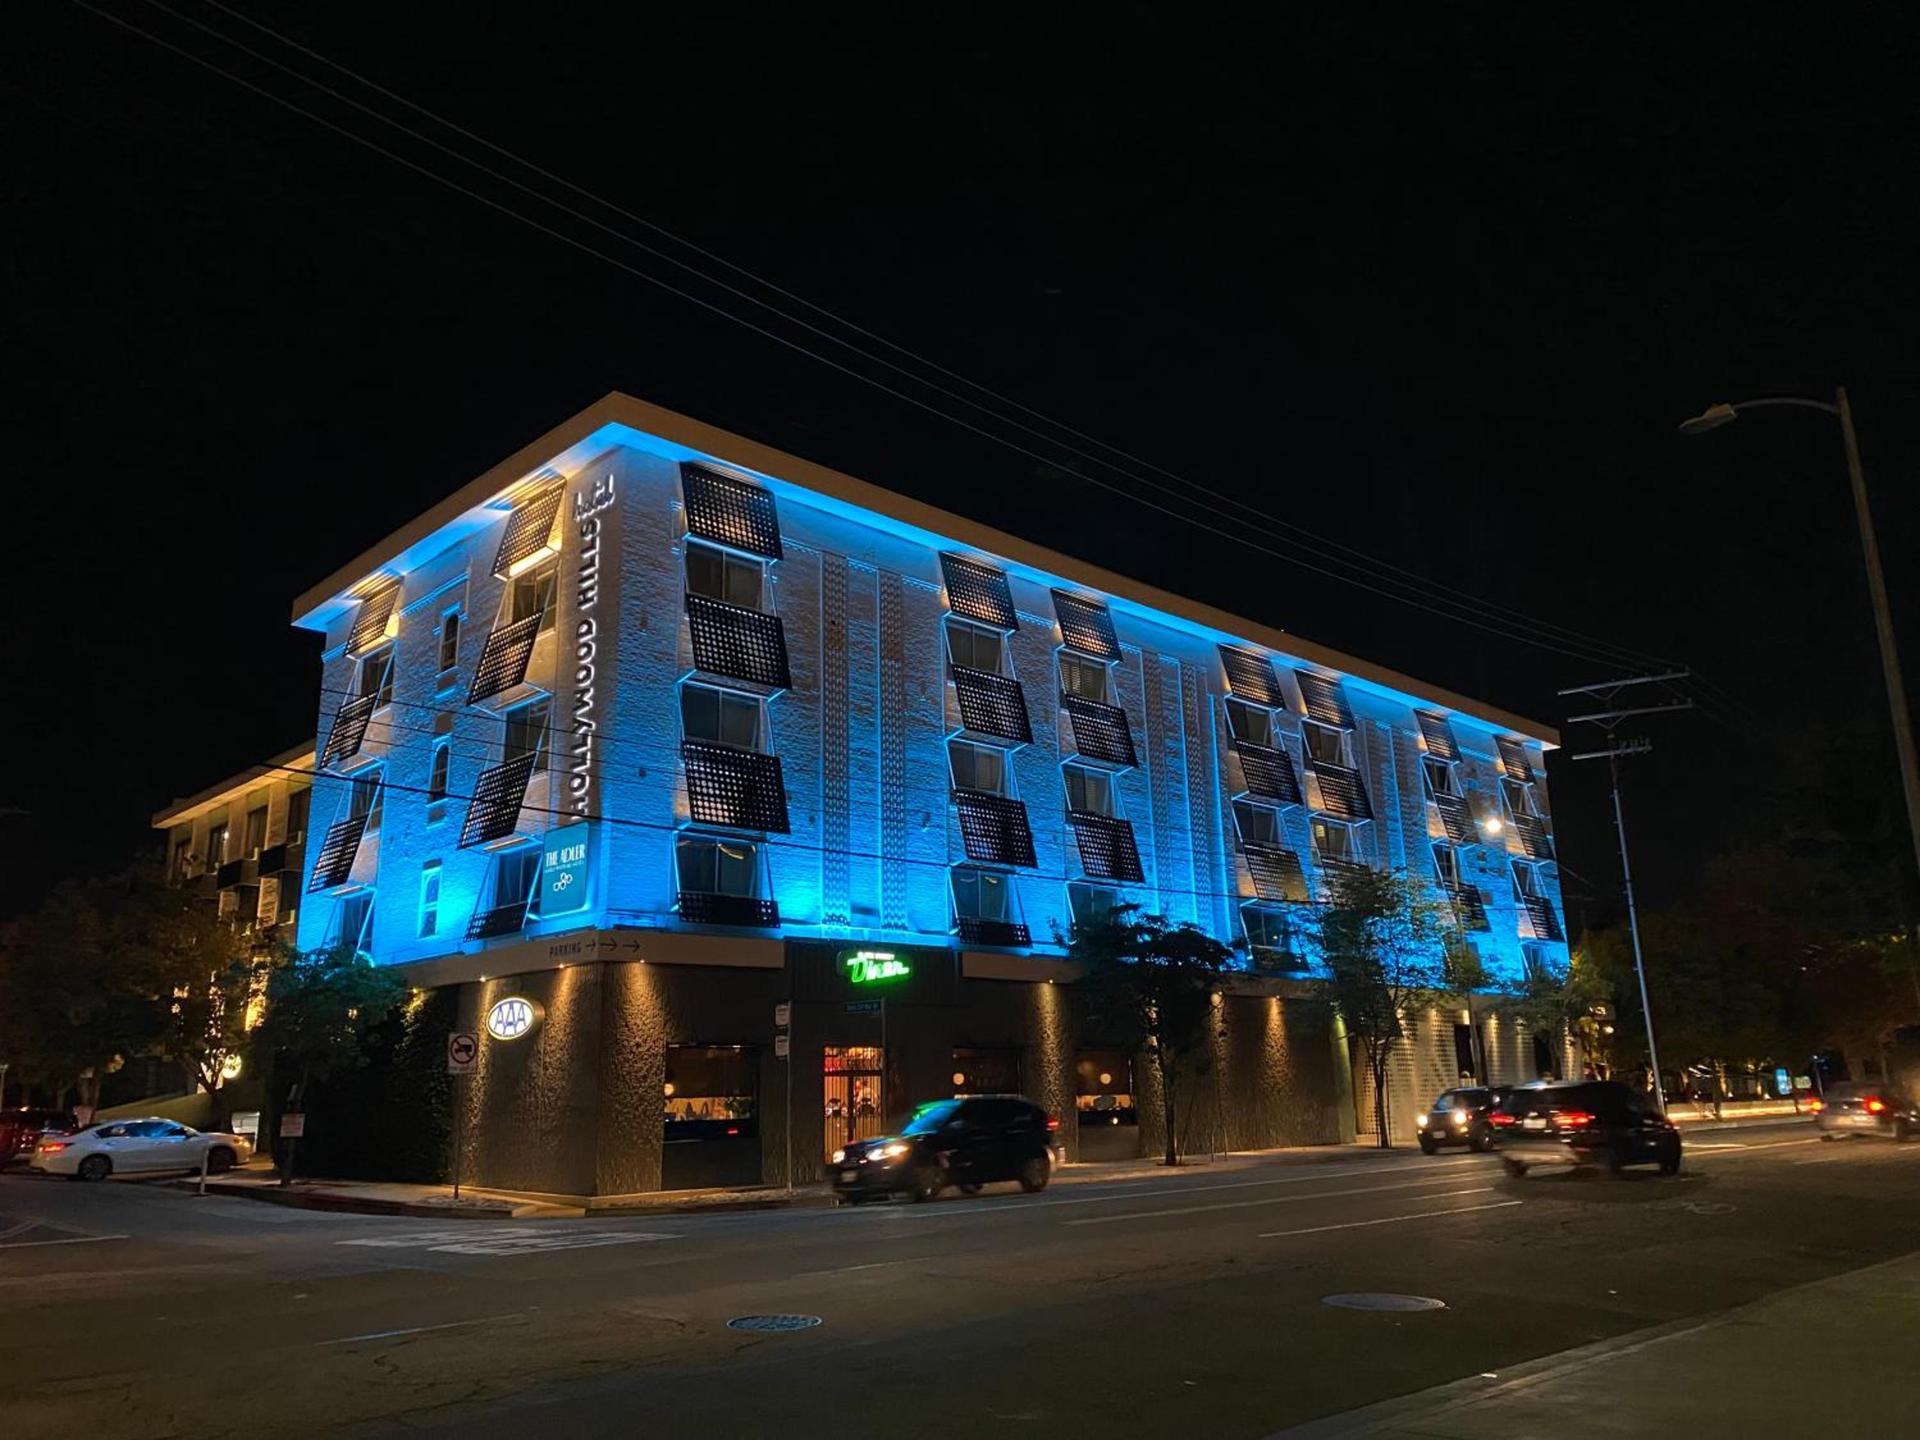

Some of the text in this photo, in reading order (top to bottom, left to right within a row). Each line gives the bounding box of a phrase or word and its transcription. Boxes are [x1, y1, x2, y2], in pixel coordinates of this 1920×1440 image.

[569, 517, 600, 820] HOLLYWOOD HILLS
[545, 850, 558, 867] THE
[560, 844, 586, 863] ADLER
[549, 942, 582, 957] PARKING
[493, 1001, 527, 1035] AAA
